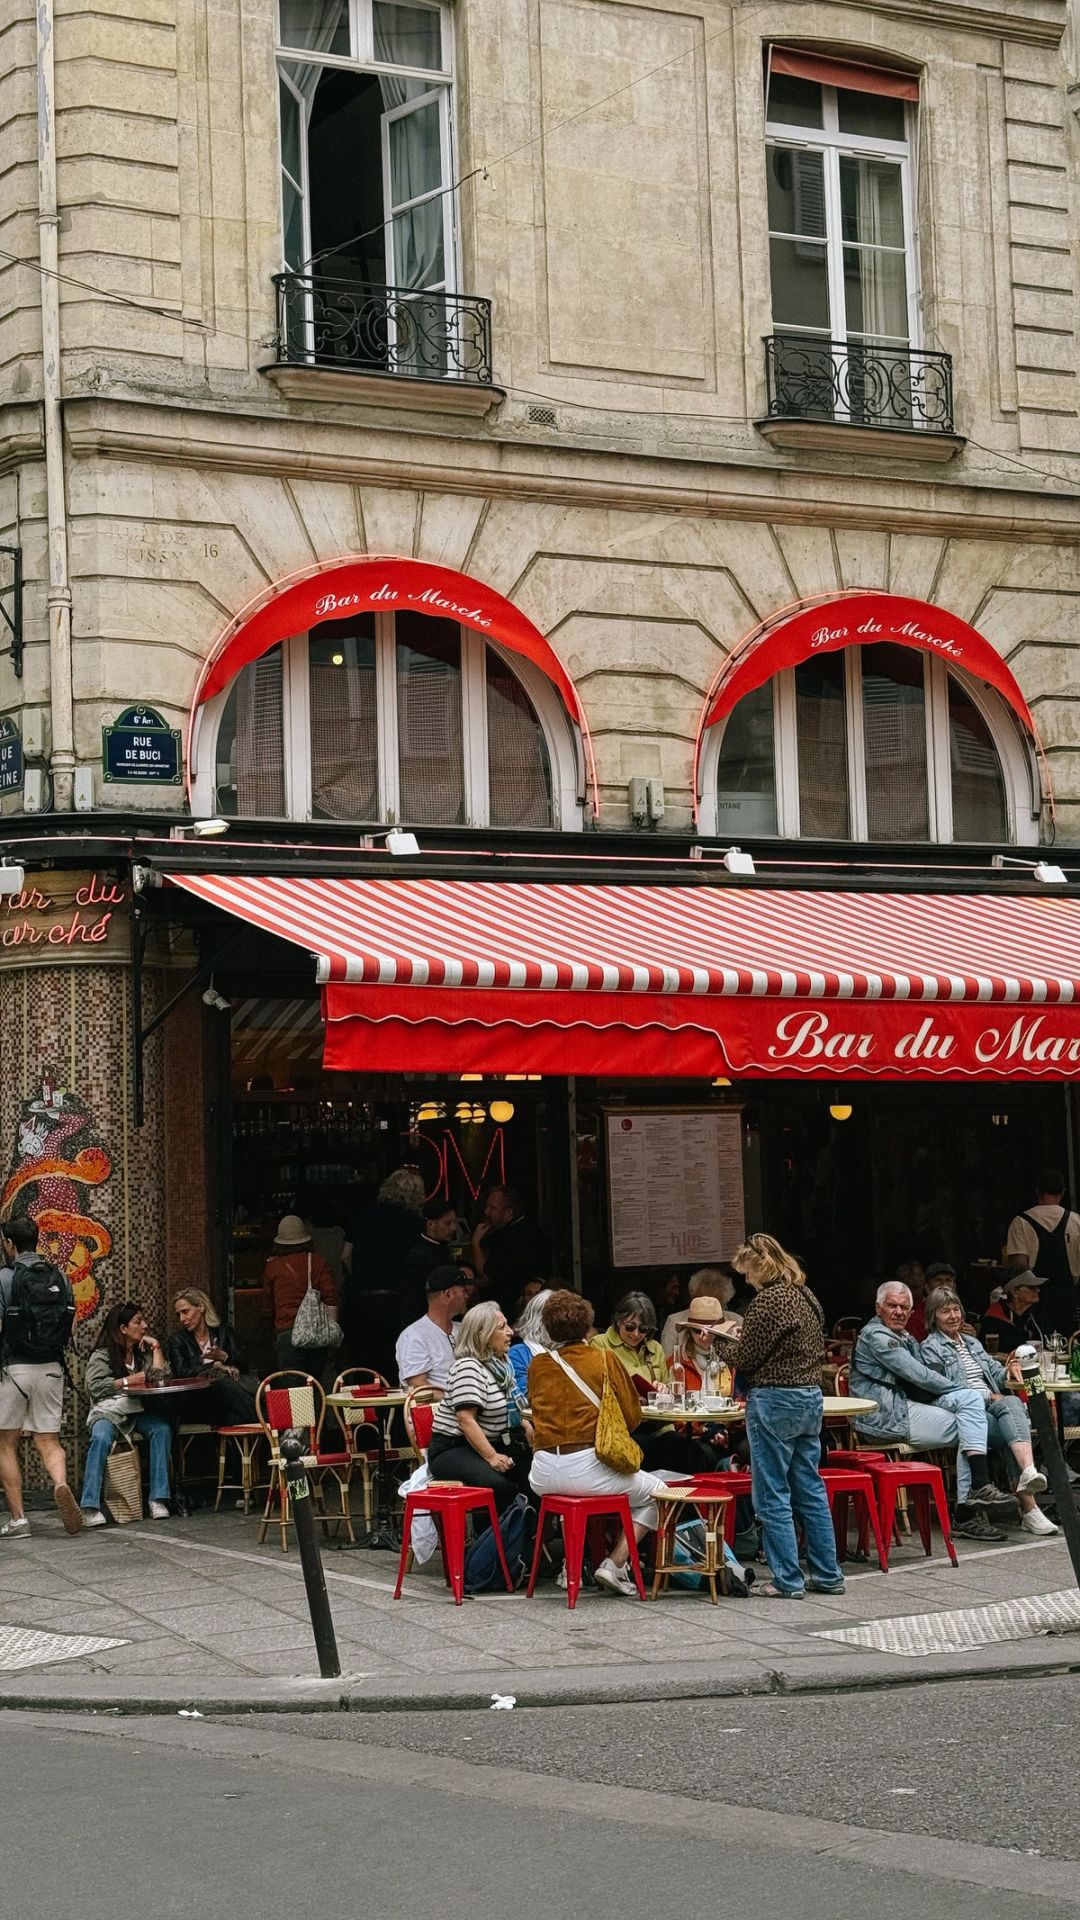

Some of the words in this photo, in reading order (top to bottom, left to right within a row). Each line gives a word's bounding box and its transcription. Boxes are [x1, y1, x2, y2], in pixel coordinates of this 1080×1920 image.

[204, 543, 218, 558] 16
[315, 593, 360, 616] Bar
[369, 583, 399, 601] du
[407, 588, 493, 629] Marché
[811, 626, 849, 648] Bar
[857, 617, 883, 634] du
[889, 621, 964, 658] Marché
[125, 749, 138, 760] DE
[139, 750, 161, 761] BUCI
[133, 736, 152, 747] RUE
[0, 887, 52, 909] ar
[76, 873, 125, 905] du
[768, 1010, 878, 1059] Bar
[894, 1016, 959, 1060] du
[974, 1014, 1080, 1063] Mar
